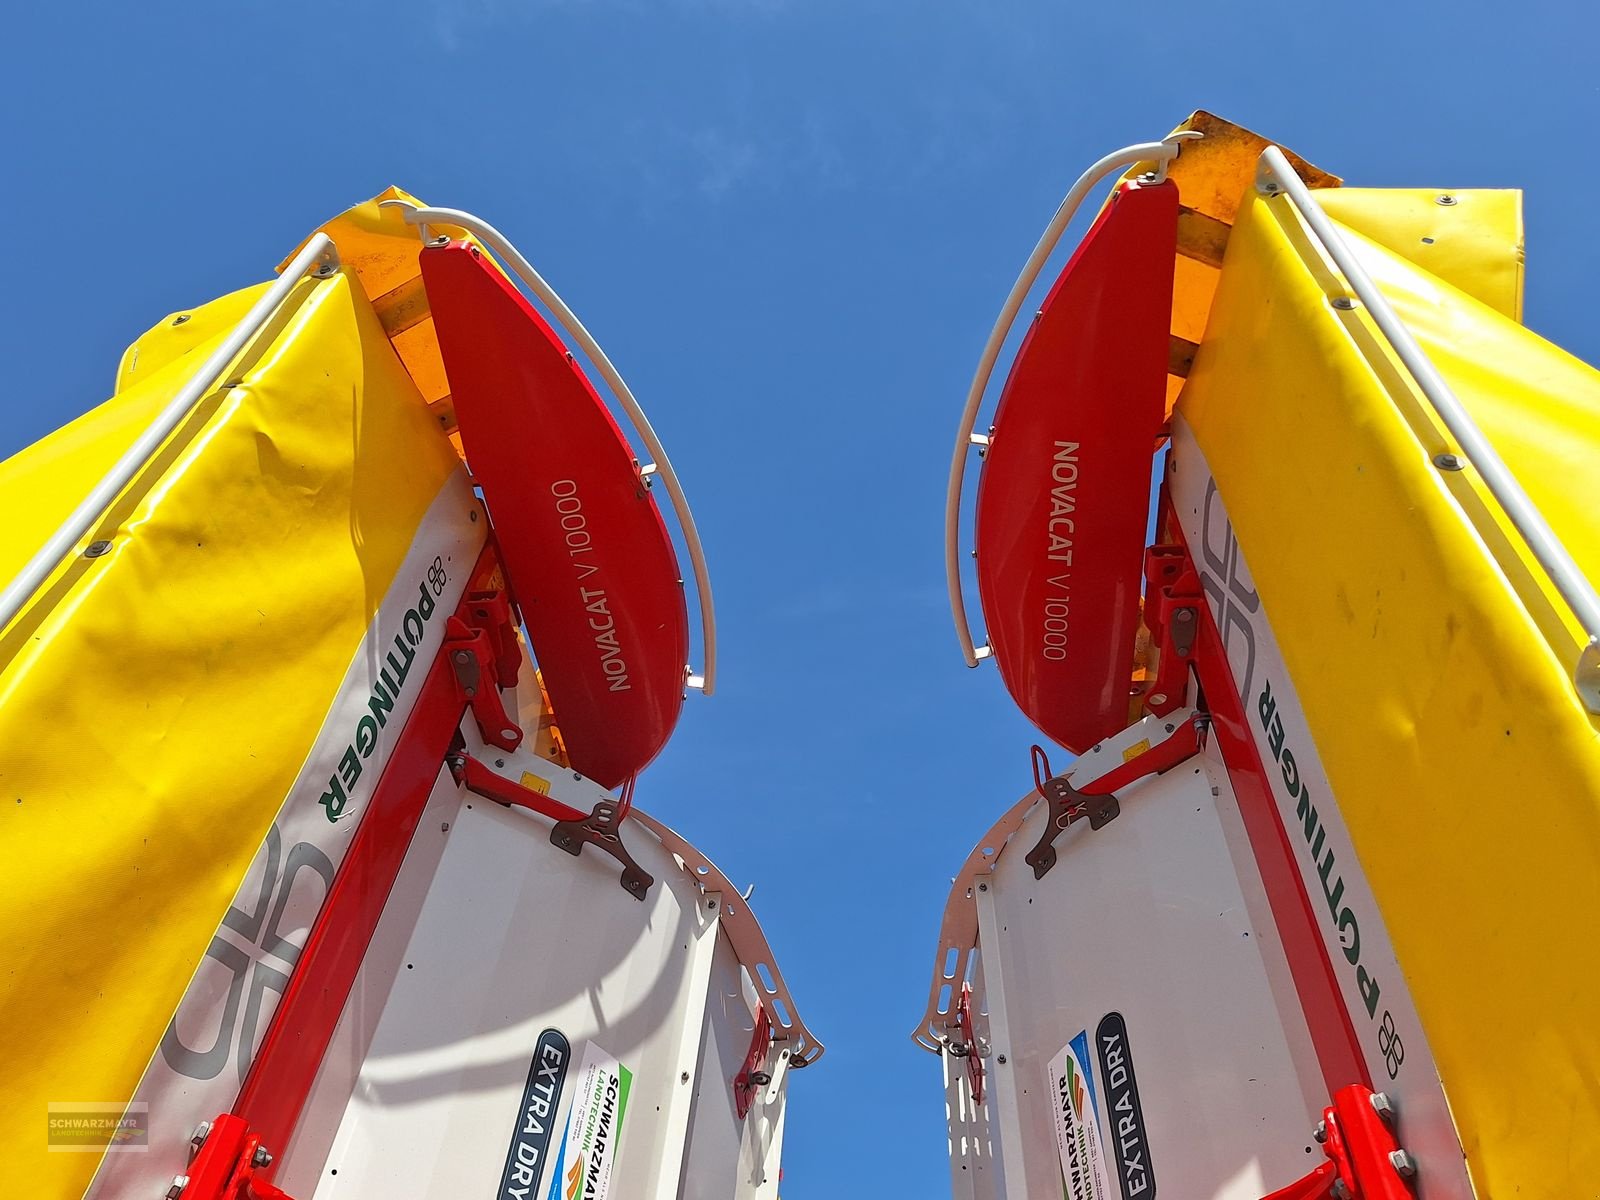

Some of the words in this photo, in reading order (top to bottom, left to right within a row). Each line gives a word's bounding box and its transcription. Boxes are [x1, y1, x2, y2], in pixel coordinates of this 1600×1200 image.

[551, 479, 593, 557] 10000
[1047, 440, 1080, 567] NOVACAT
[573, 563, 599, 580] V
[1046, 574, 1071, 590] V
[580, 587, 632, 692] NOVACAT
[1043, 596, 1070, 661] 10000
[318, 581, 435, 823] PÖTTINGER
[1258, 679, 1381, 1020] PÖTTINGER
[523, 1043, 563, 1135] EXTRA
[1102, 1033, 1128, 1090] DRY
[581, 1069, 607, 1152] LANDTECHNIK
[584, 1074, 619, 1200] SCHWARZMA
[1114, 1089, 1148, 1197] EXTRA
[507, 1141, 539, 1200] DRY
